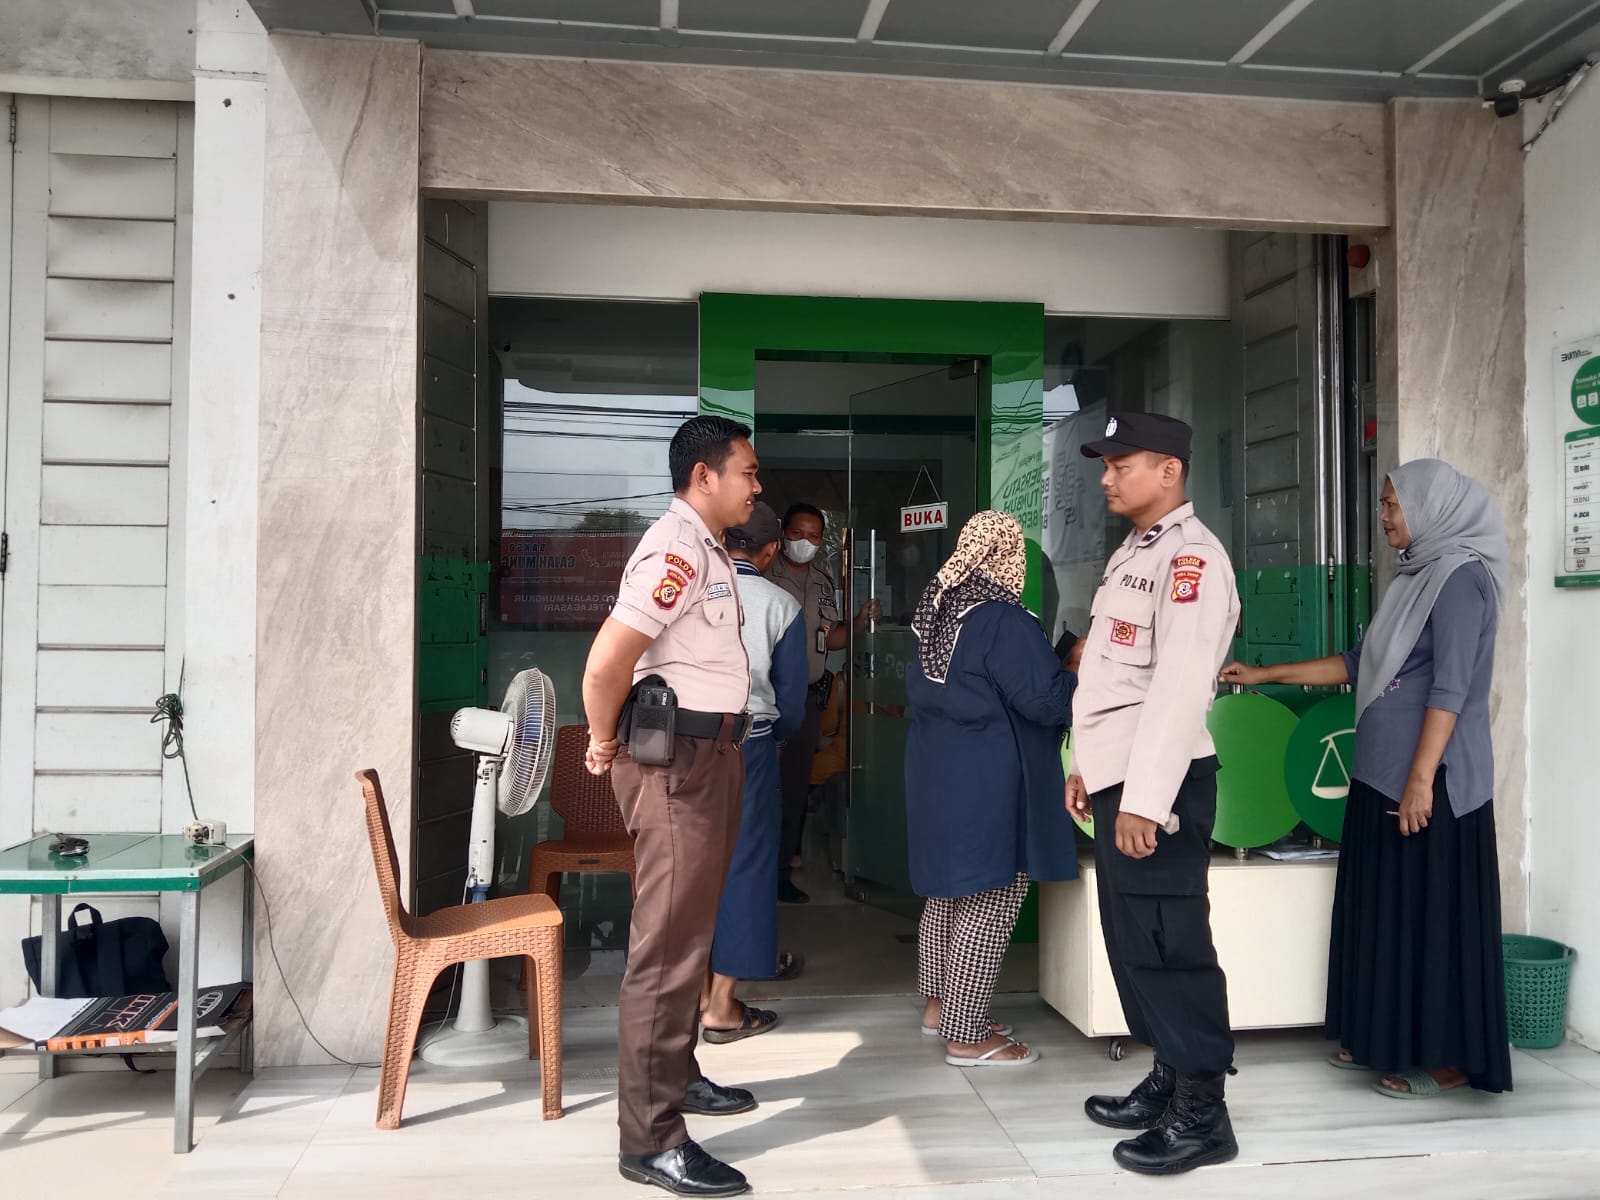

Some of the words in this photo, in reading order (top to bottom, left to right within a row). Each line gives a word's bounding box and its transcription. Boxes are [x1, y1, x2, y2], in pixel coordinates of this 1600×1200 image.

[903, 510, 944, 527] BUKA
[667, 554, 694, 577] POLDA
[1119, 574, 1155, 593] POLRI
